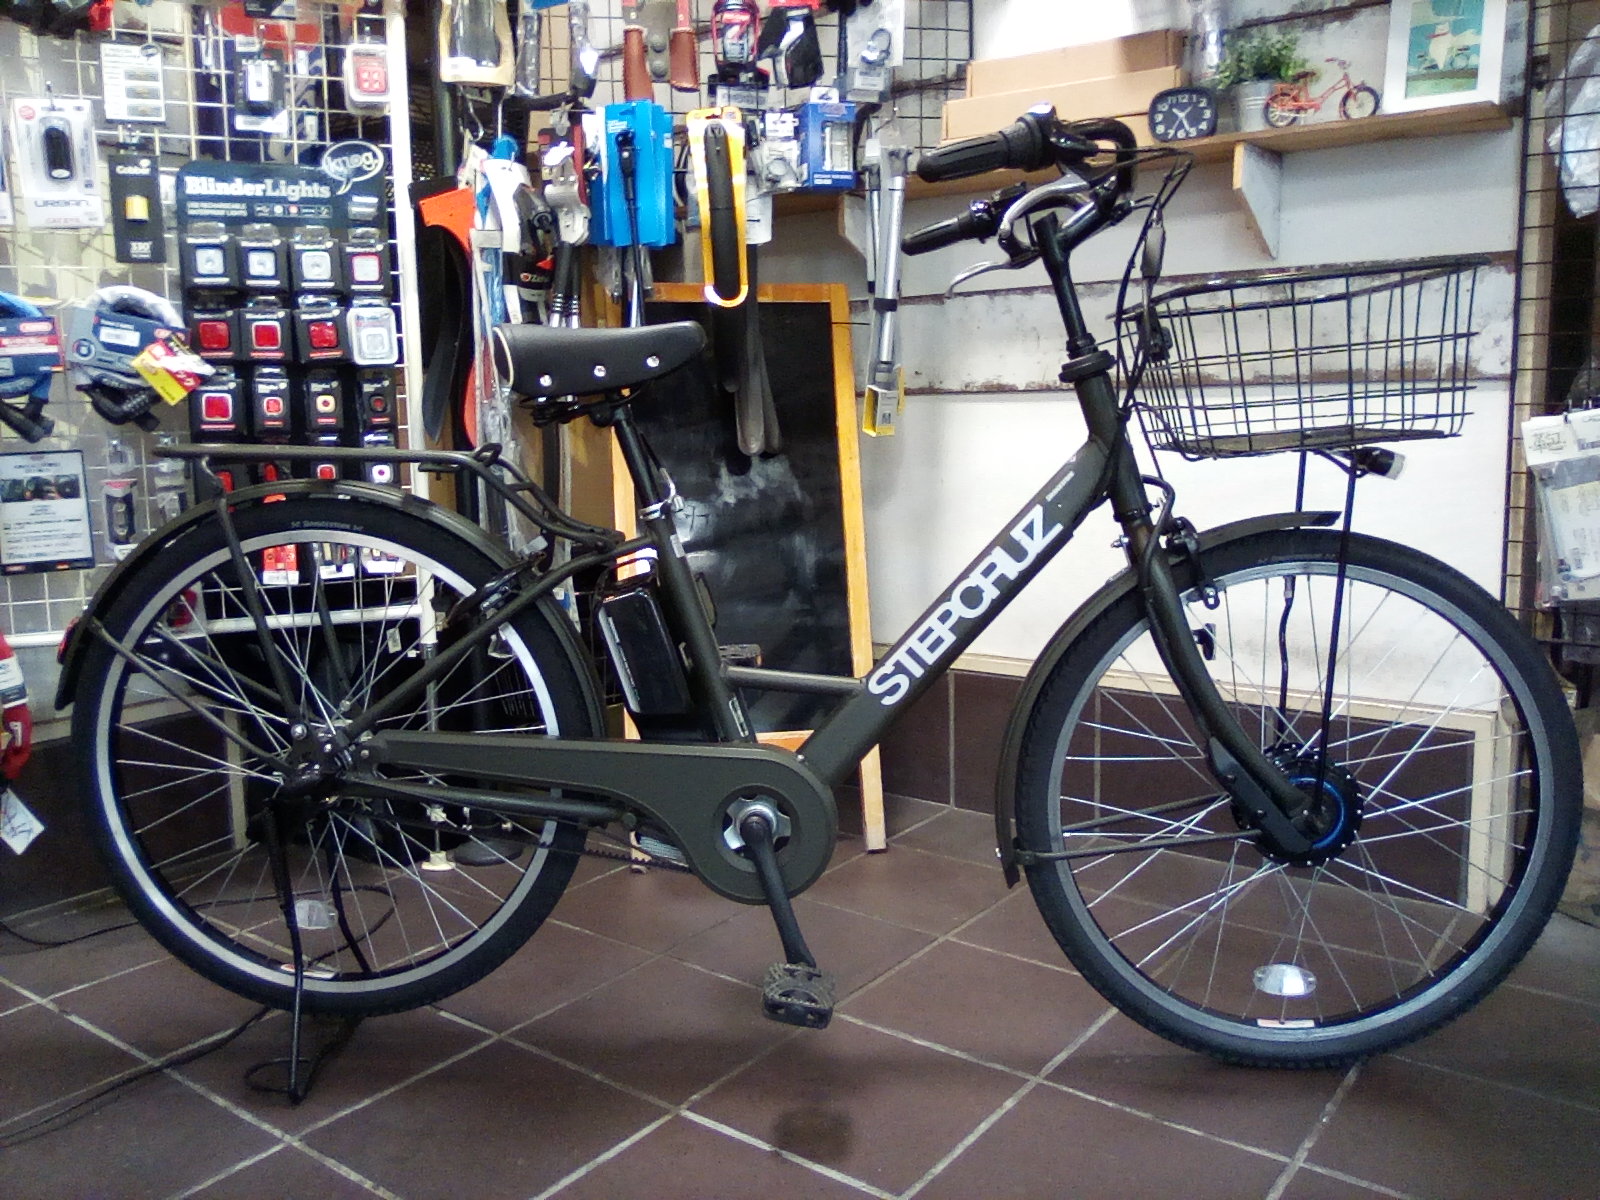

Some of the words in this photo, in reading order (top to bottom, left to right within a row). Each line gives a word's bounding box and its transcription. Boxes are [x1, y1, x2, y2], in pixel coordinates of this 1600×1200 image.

[1178, 94, 1189, 103] 12
[1198, 98, 1207, 107] 2
[1157, 103, 1169, 111] 10
[1154, 113, 1164, 123] 9
[1202, 109, 1212, 119] 3
[1156, 124, 1165, 134] 8
[1199, 121, 1208, 130] 4
[1167, 129, 1175, 139] 7
[1177, 129, 1186, 138] 6
[1188, 127, 1197, 137] 5
[868, 504, 1064, 706] STEPCRUZ
